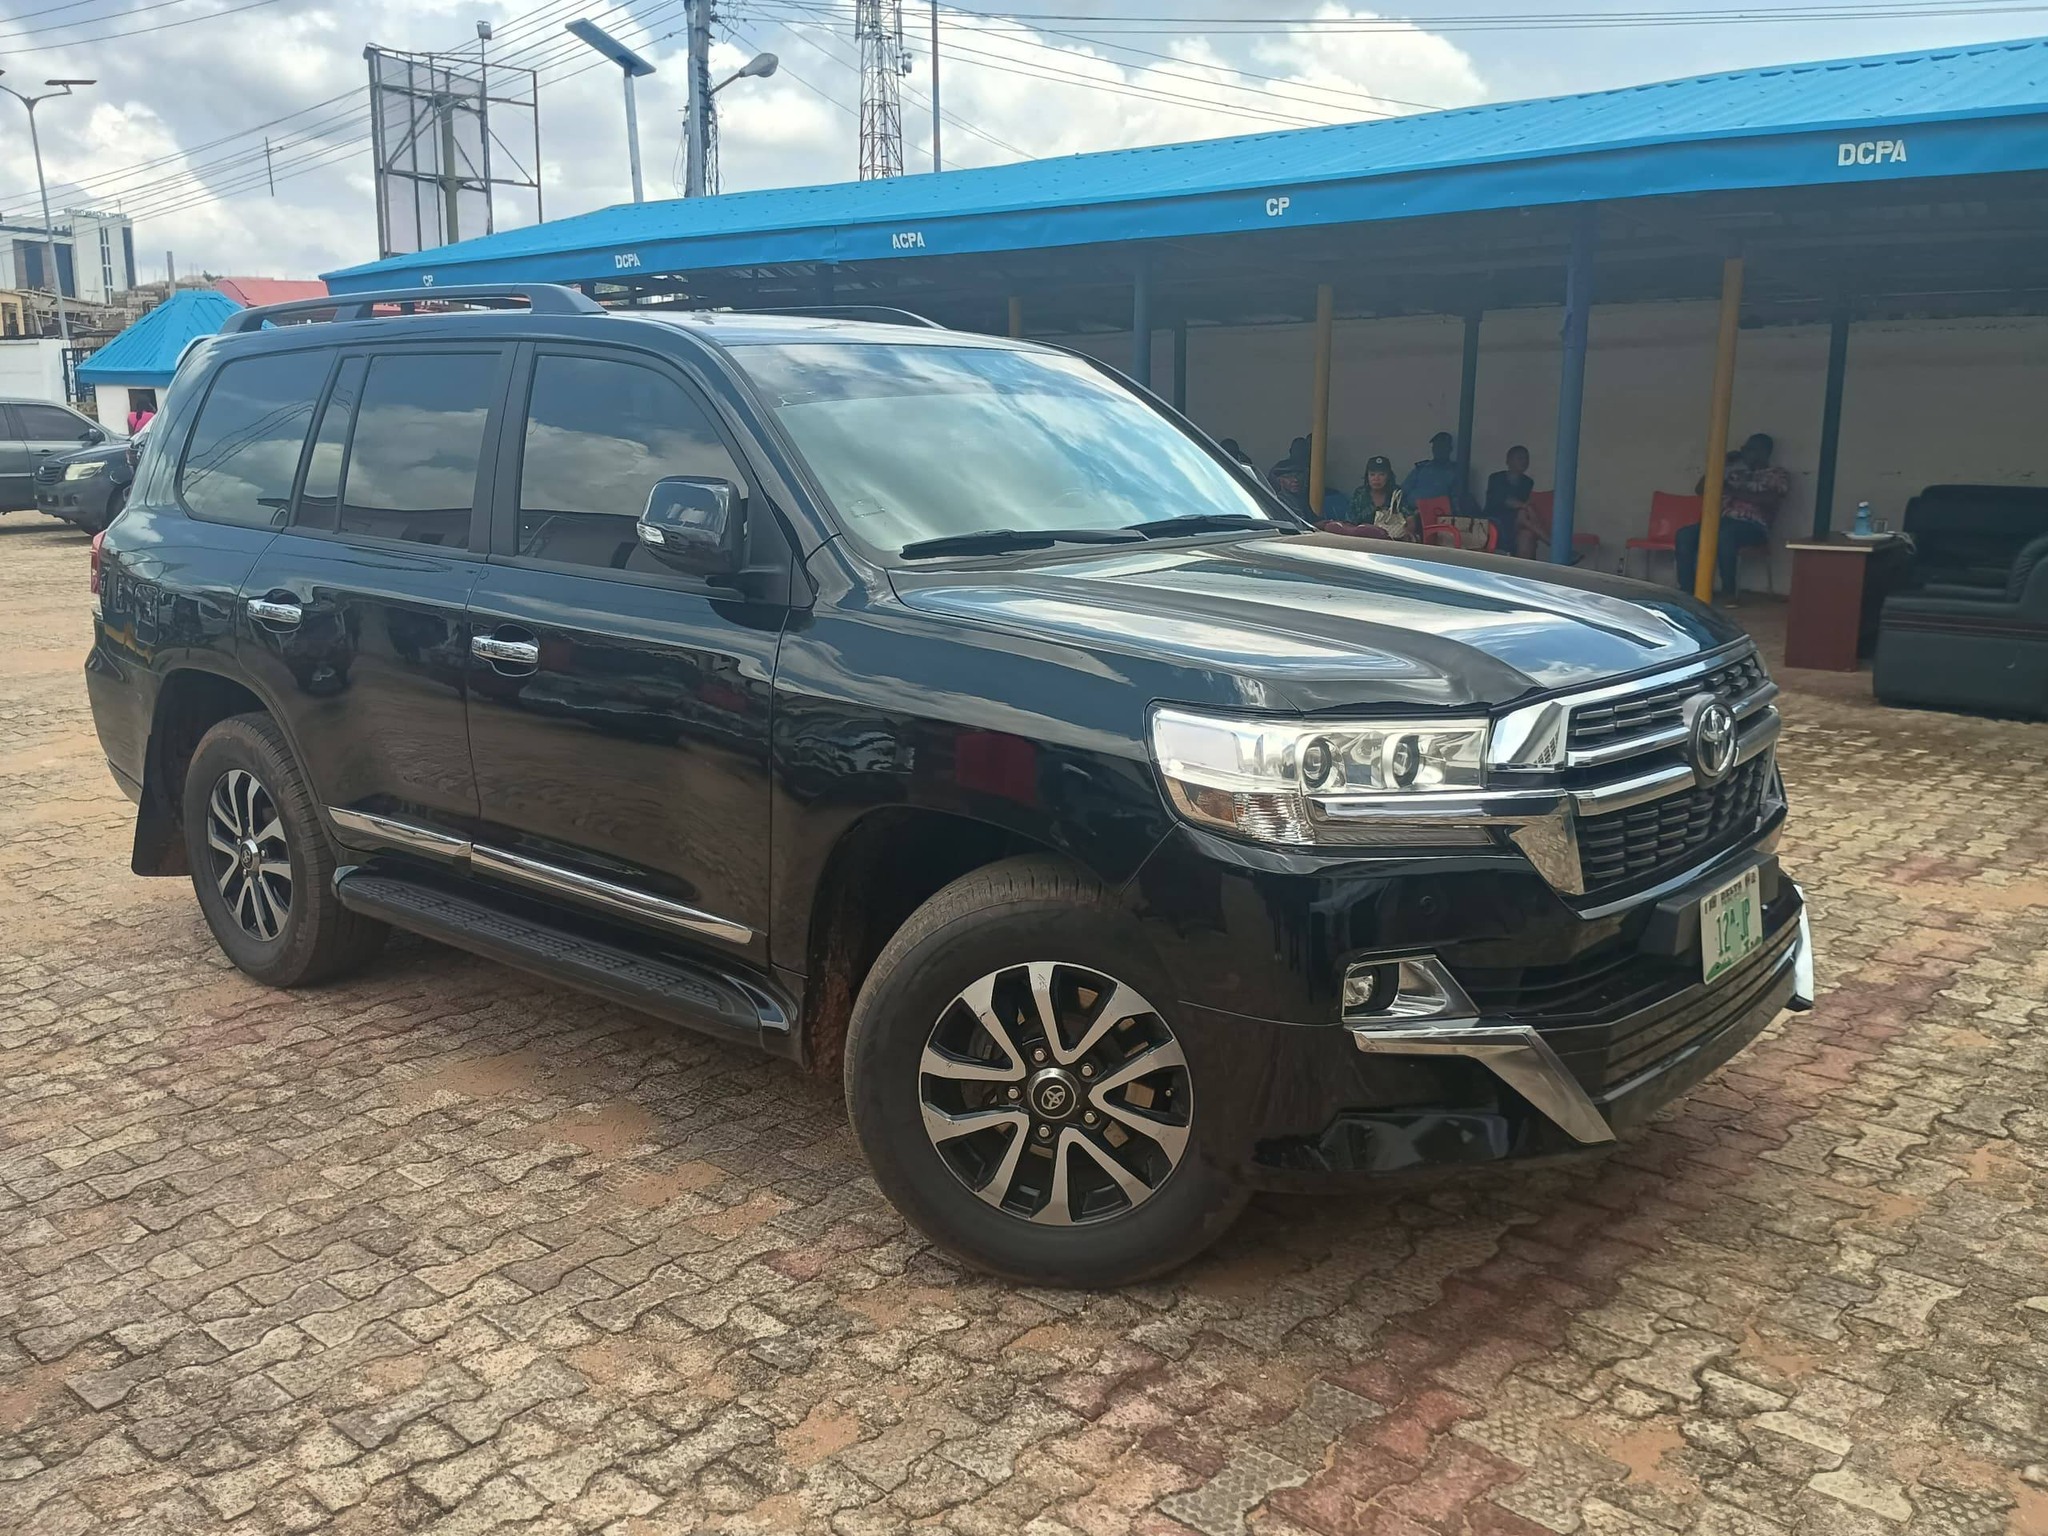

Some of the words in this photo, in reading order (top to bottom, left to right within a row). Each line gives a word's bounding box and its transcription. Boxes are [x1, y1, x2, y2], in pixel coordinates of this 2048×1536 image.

[1838, 139, 1907, 166] DCPA
[1266, 197, 1290, 217] CP
[892, 231, 926, 249] ACPA
[614, 252, 641, 269] DCPA
[422, 274, 434, 287] CP
